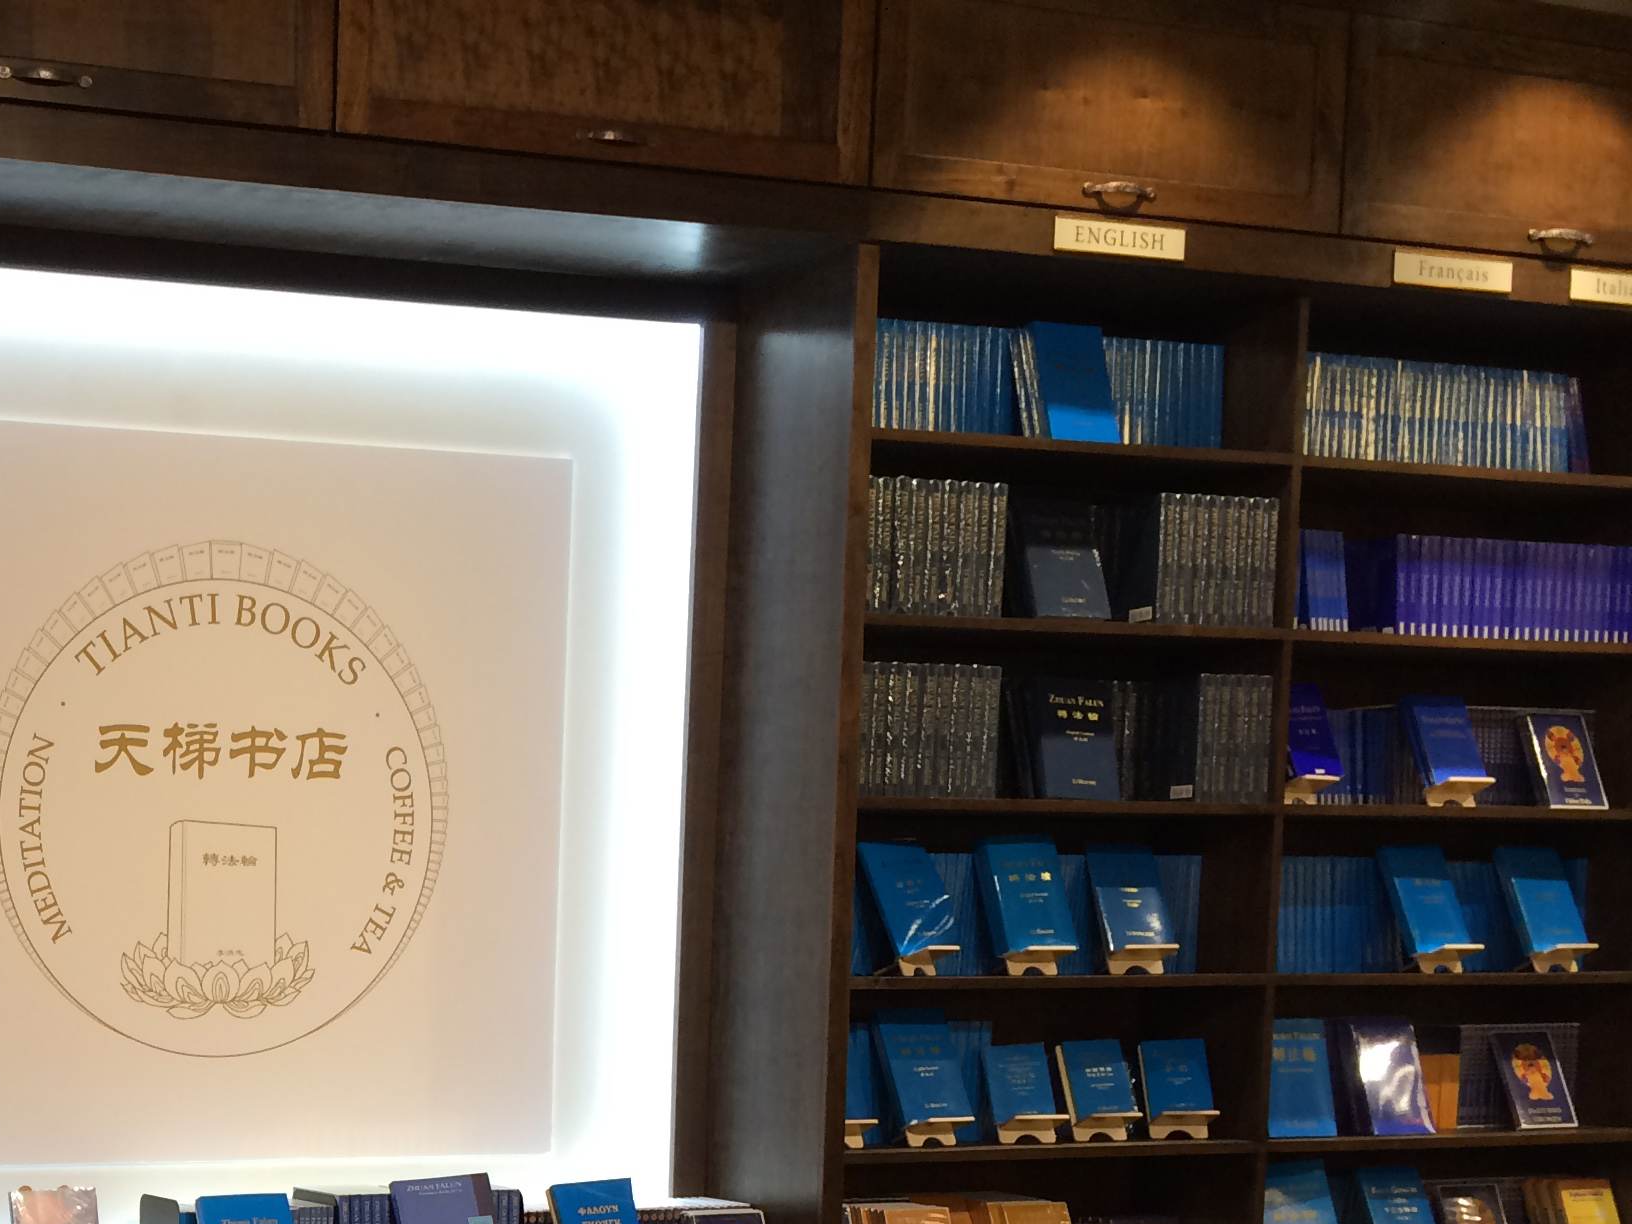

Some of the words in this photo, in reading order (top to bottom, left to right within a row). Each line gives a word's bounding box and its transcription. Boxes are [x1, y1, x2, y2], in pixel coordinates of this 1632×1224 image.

[1074, 225, 1165, 251] ENGLISH
[1419, 260, 1489, 283] Français
[1596, 278, 1632, 297] Itali
[74, 593, 220, 676] TIANTI
[235, 594, 366, 685] BOOKS
[94, 722, 348, 780] 天梯书店
[385, 746, 415, 866] COFFEE
[18, 732, 73, 944] MEDITATION
[382, 872, 405, 895] &
[350, 902, 396, 956] TEA
